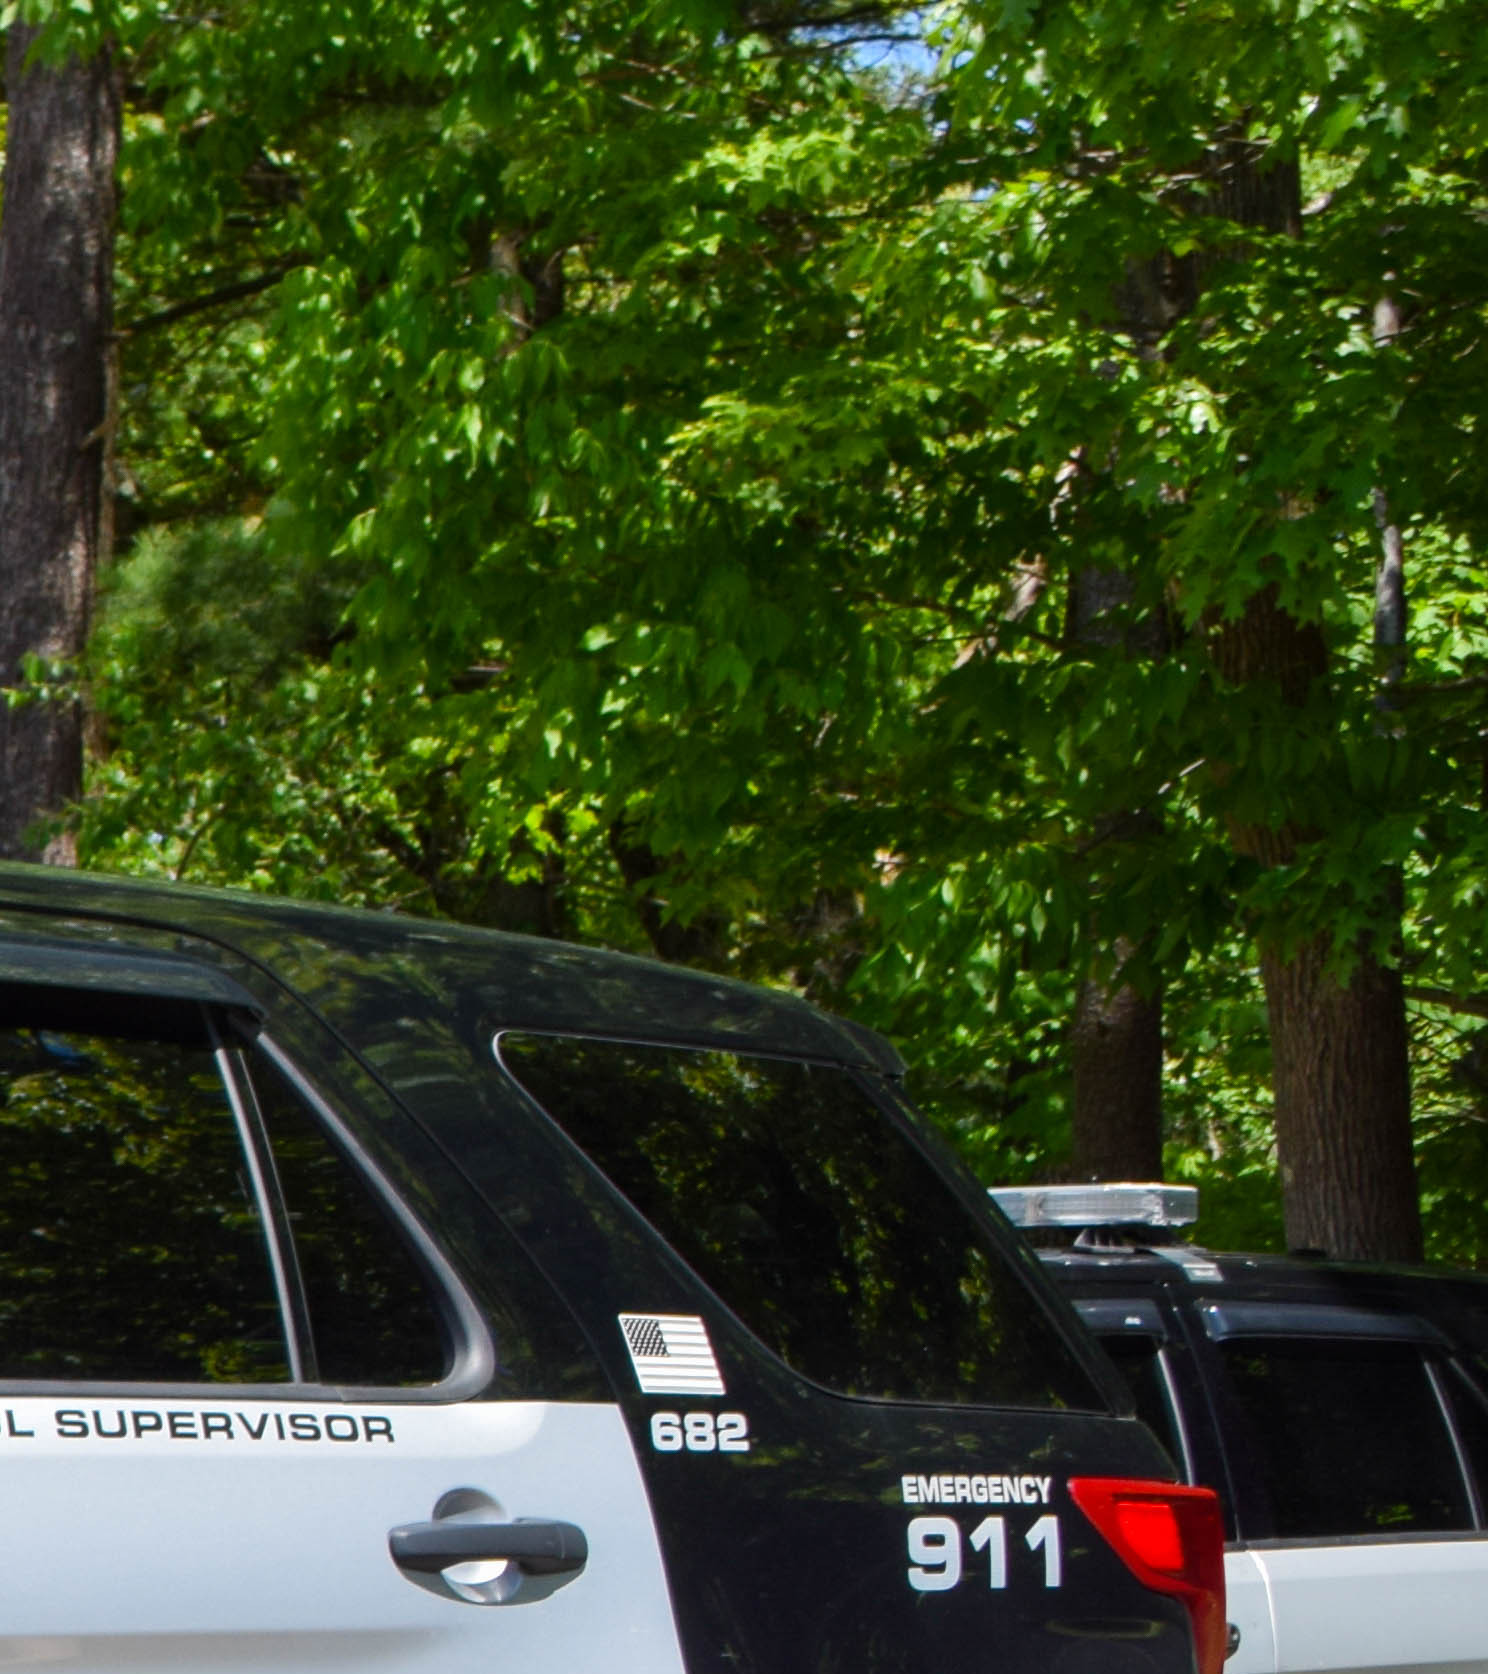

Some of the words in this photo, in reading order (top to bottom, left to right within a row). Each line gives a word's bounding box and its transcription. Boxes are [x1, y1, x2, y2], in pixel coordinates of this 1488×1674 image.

[53, 1410, 397, 1445] SUPERVISOR
[649, 1411, 751, 1452] 682
[900, 1475, 1052, 1504] EMERGENCY
[907, 1514, 1063, 1592] 911
